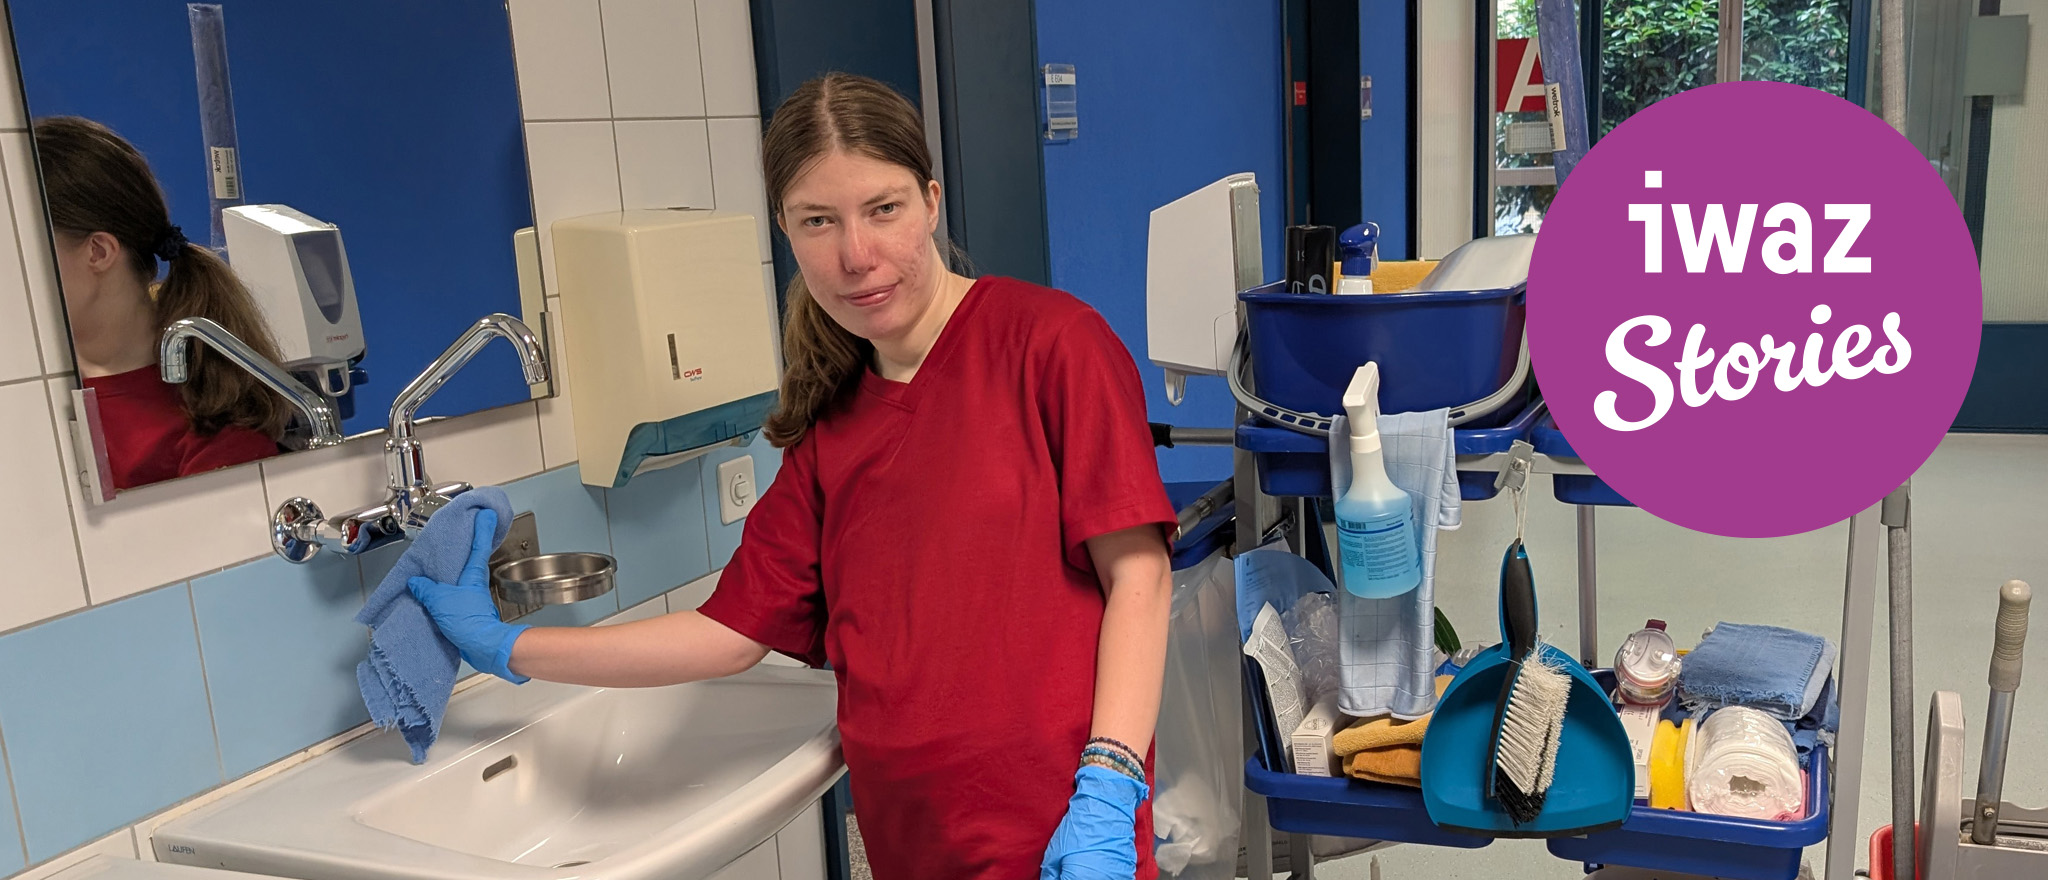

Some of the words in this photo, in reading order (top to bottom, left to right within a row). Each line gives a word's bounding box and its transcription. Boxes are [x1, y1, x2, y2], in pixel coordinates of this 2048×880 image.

[1504, 37, 1547, 112] A
[1551, 87, 1560, 117] wetrok
[684, 368, 702, 378] CWS
[168, 844, 195, 855] LAUFEN
